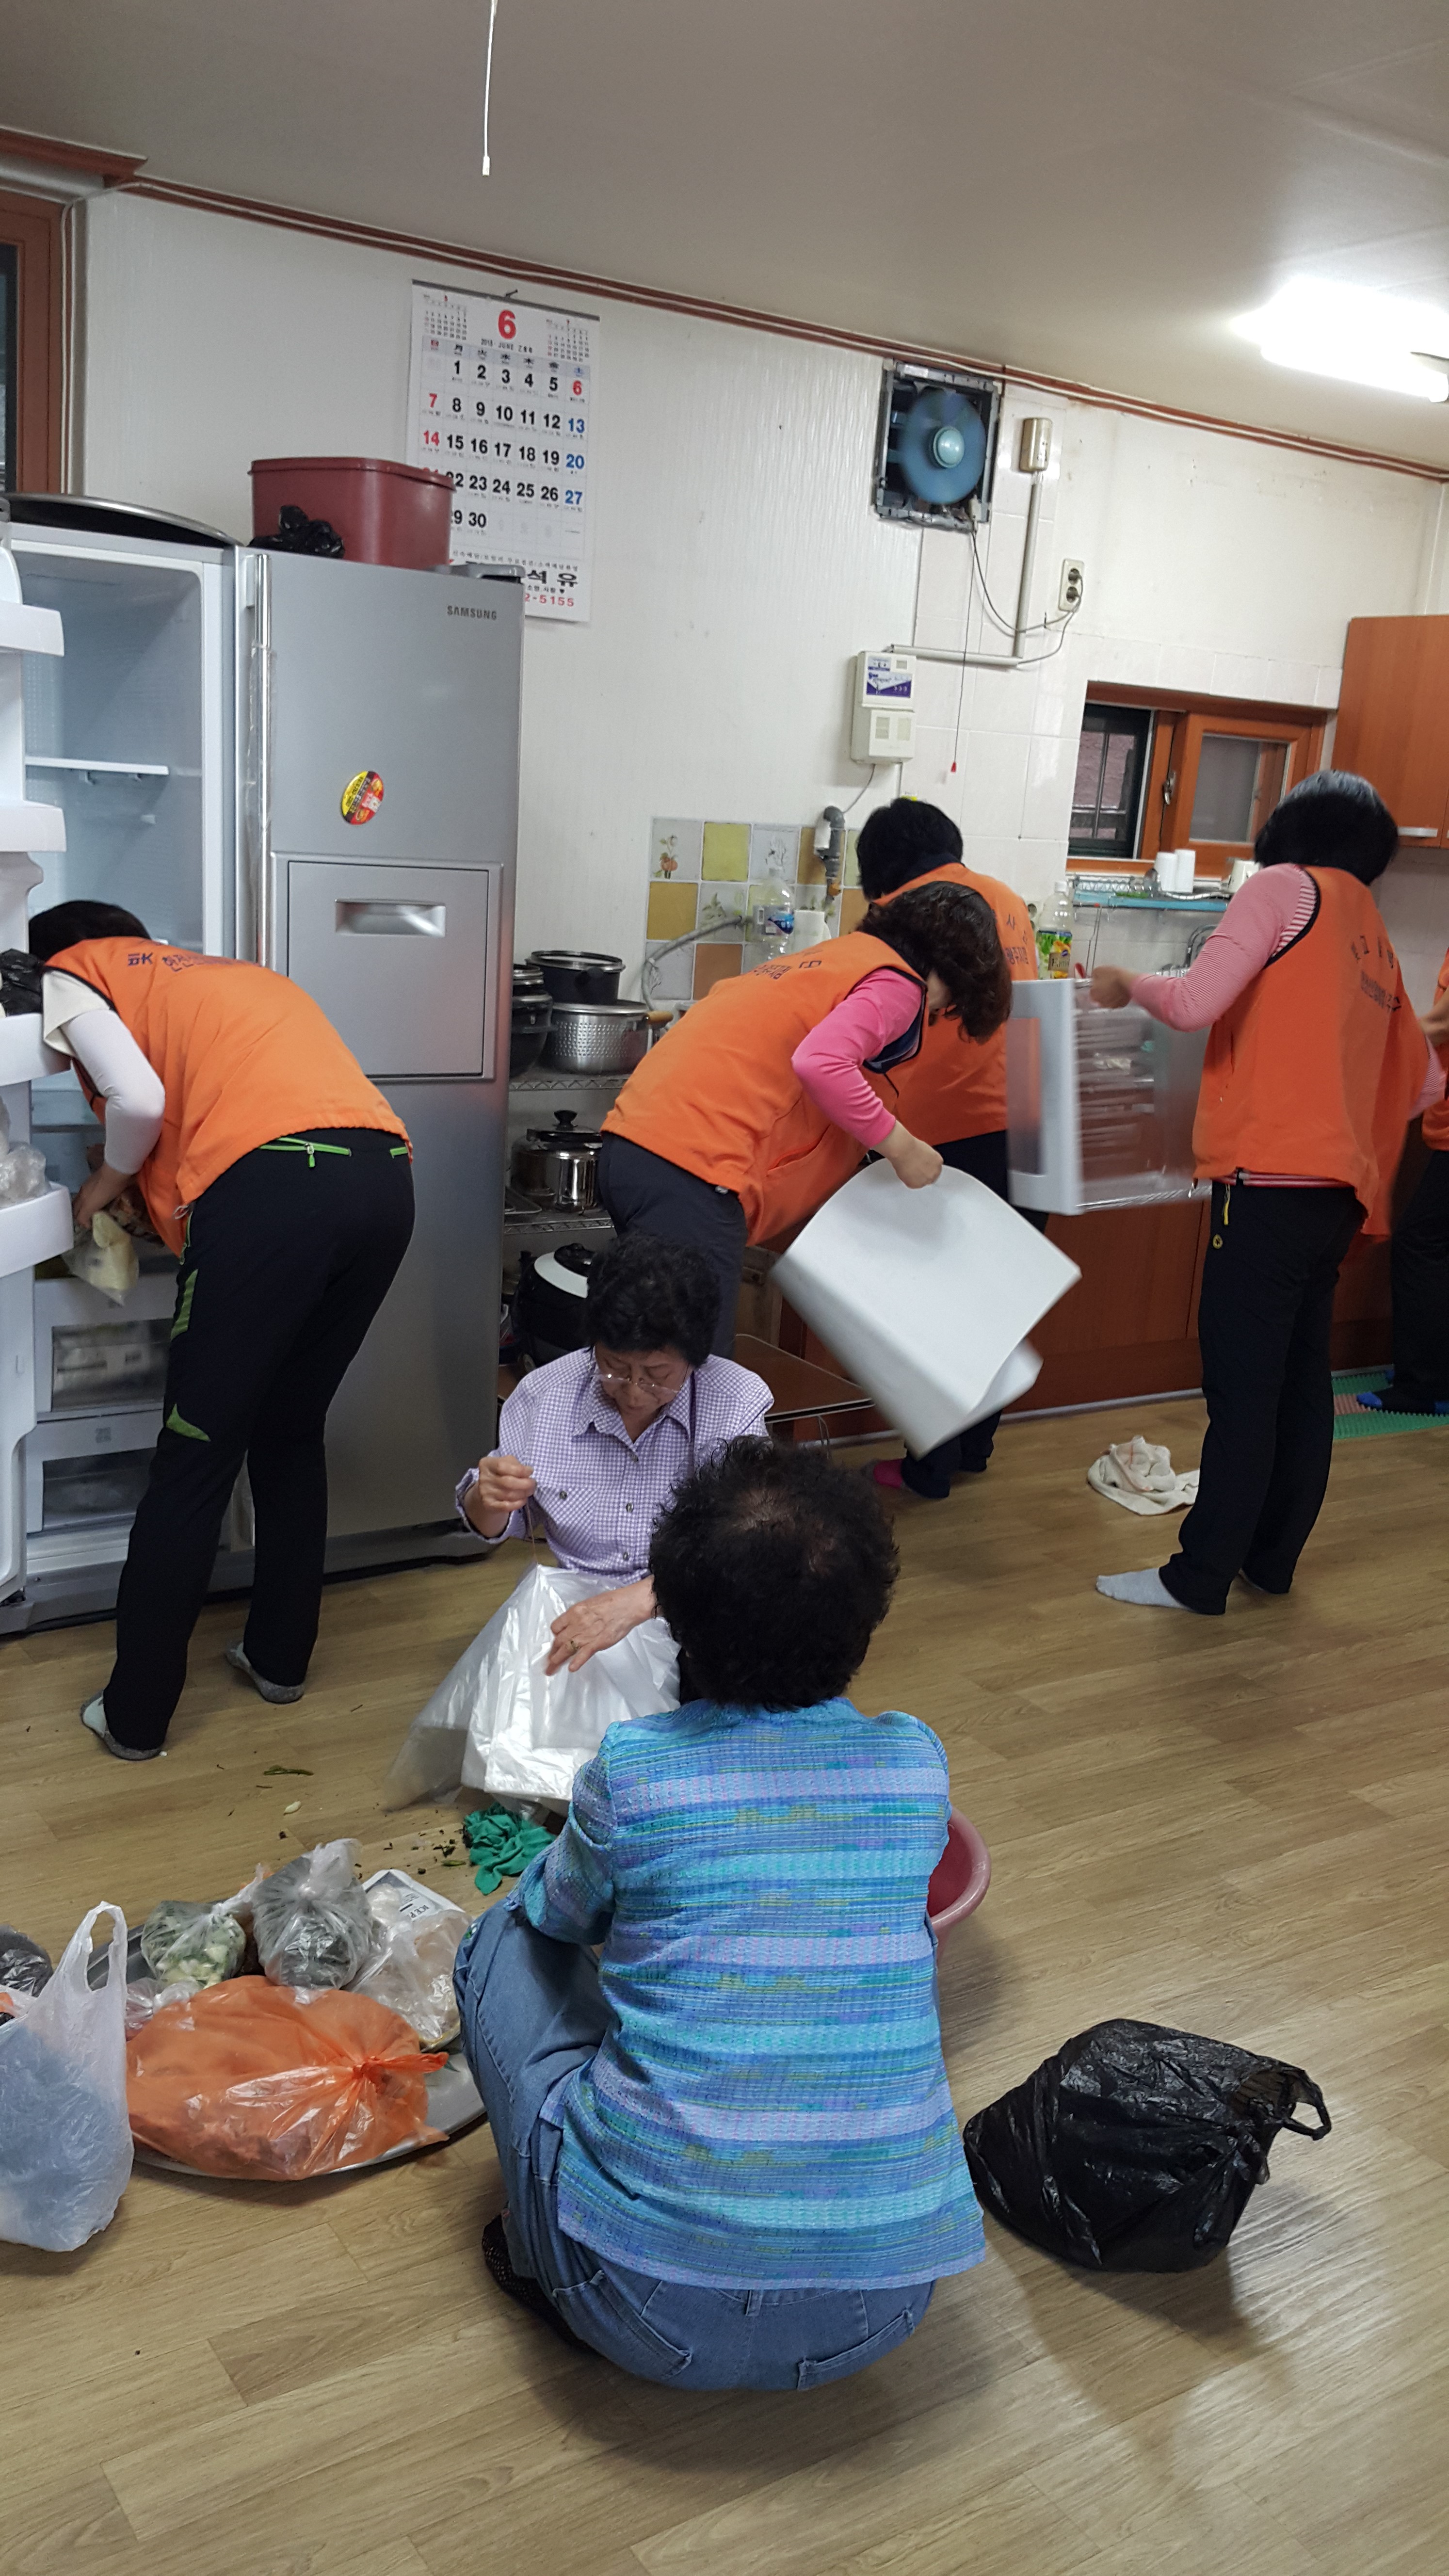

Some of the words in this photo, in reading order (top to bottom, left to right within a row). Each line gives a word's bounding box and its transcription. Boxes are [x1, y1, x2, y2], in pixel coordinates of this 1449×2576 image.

[498, 309, 516, 339] 6
[454, 360, 460, 375] 1
[477, 364, 486, 380] 2
[501, 369, 511, 384] 3
[524, 373, 534, 388] 4
[549, 376, 558, 391] 5
[572, 380, 582, 396] 6
[429, 393, 437, 408] 7
[452, 397, 462, 413] 8
[476, 402, 485, 417] 9
[496, 405, 513, 421] 10
[520, 409, 535, 425] 11
[543, 413, 561, 430] 12
[568, 418, 585, 434] 13
[423, 430, 440, 447] 14
[447, 434, 464, 450] 15
[470, 438, 488, 454] 16
[494, 442, 511, 458] 17
[519, 446, 535, 462] 18
[542, 450, 560, 466] 19
[565, 453, 585, 469] 20
[469, 474, 487, 491] 23
[492, 478, 511, 495] 24
[516, 482, 534, 498] 25
[541, 485, 559, 501] 26
[565, 489, 582, 505] 27
[451, 509, 463, 524] 9
[468, 512, 487, 528] 30
[447, 605, 497, 620] SAMSUNG
